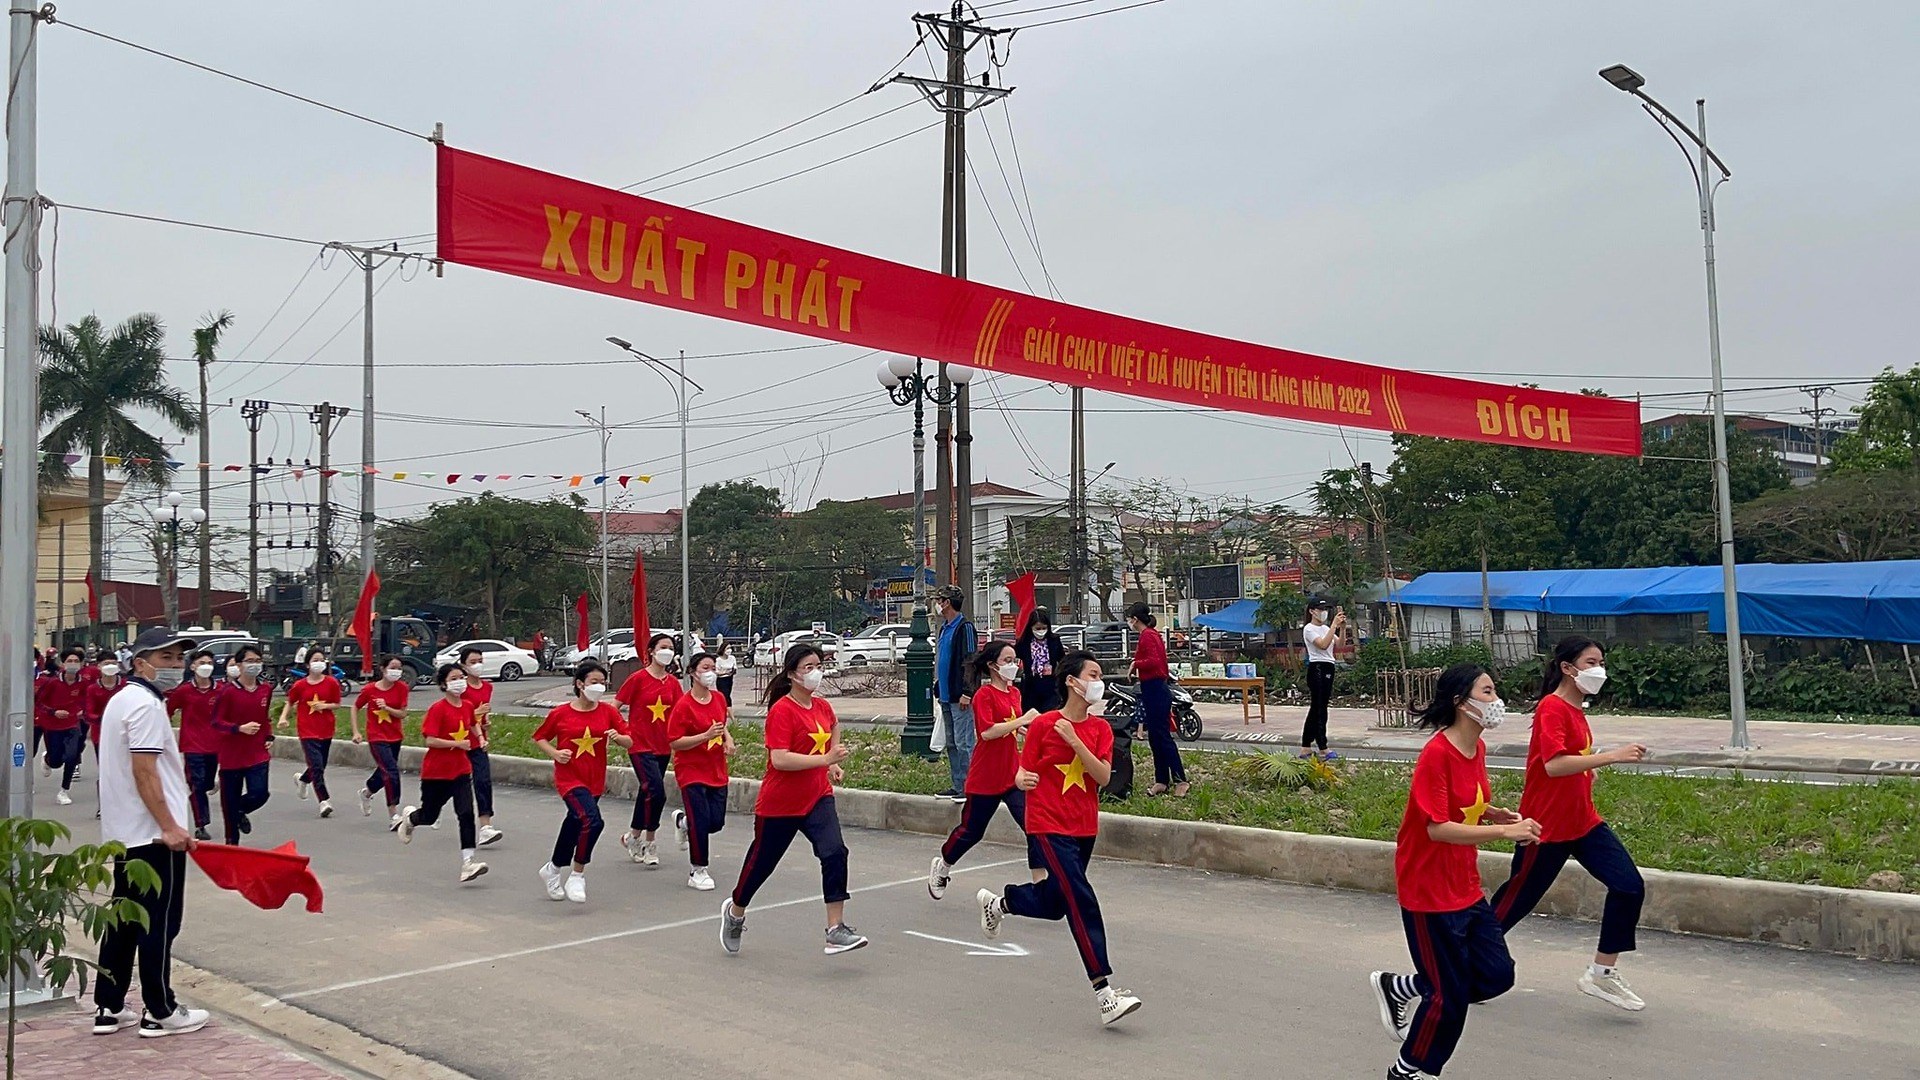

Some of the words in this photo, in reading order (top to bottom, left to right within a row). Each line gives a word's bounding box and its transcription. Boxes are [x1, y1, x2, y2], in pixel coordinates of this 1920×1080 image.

[541, 205, 706, 301] XUẤT
[724, 250, 862, 333] PHÁT
[1023, 317, 1060, 366] GIẢI
[1062, 335, 1108, 380] CHẠY
[1110, 341, 1145, 386] VIỆT
[1147, 348, 1169, 385] DÃ
[1172, 355, 1222, 399] HUYỆN
[1225, 362, 1258, 400] TIÊN
[1261, 368, 1299, 406] LÃNG
[1301, 374, 1335, 411] NĂM
[1337, 385, 1372, 416] 2022
[1476, 395, 1572, 443] ĐÍCH
